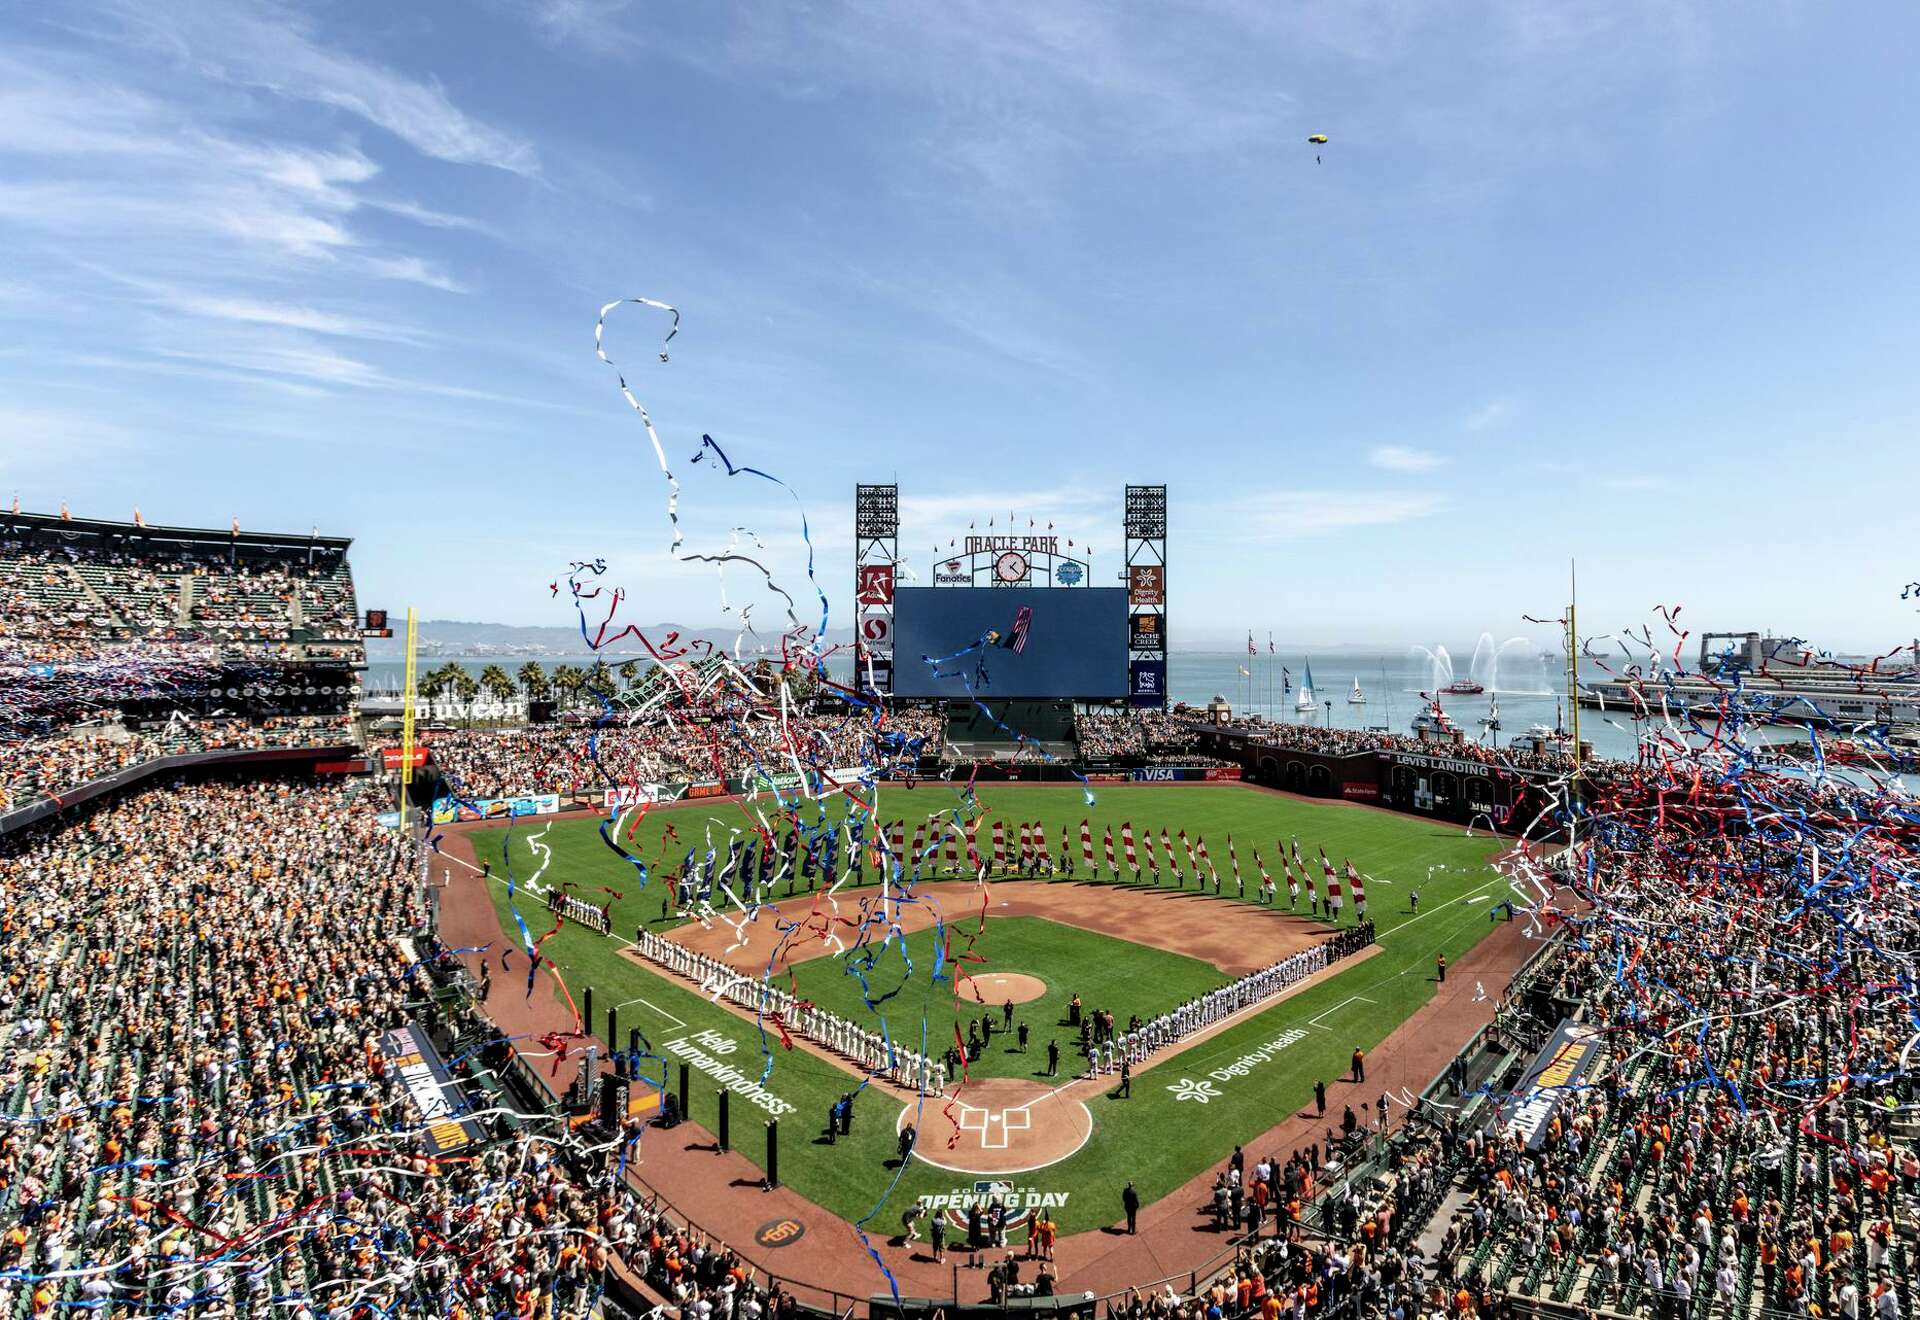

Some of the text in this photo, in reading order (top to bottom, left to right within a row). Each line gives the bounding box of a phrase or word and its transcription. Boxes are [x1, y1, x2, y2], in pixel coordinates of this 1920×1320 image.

[965, 536, 1058, 554] ORACLE PARK
[935, 573, 972, 583] Fanatics
[1134, 589, 1158, 598] Dignity
[414, 702, 523, 720] nuveen
[1144, 769, 1175, 781] VISA
[1430, 759, 1489, 777] LANDING
[690, 1029, 738, 1055] Hello
[1208, 1027, 1311, 1082] Dignity Health
[1025, 1192, 1070, 1208] DAY
[761, 1221, 800, 1241] SF
